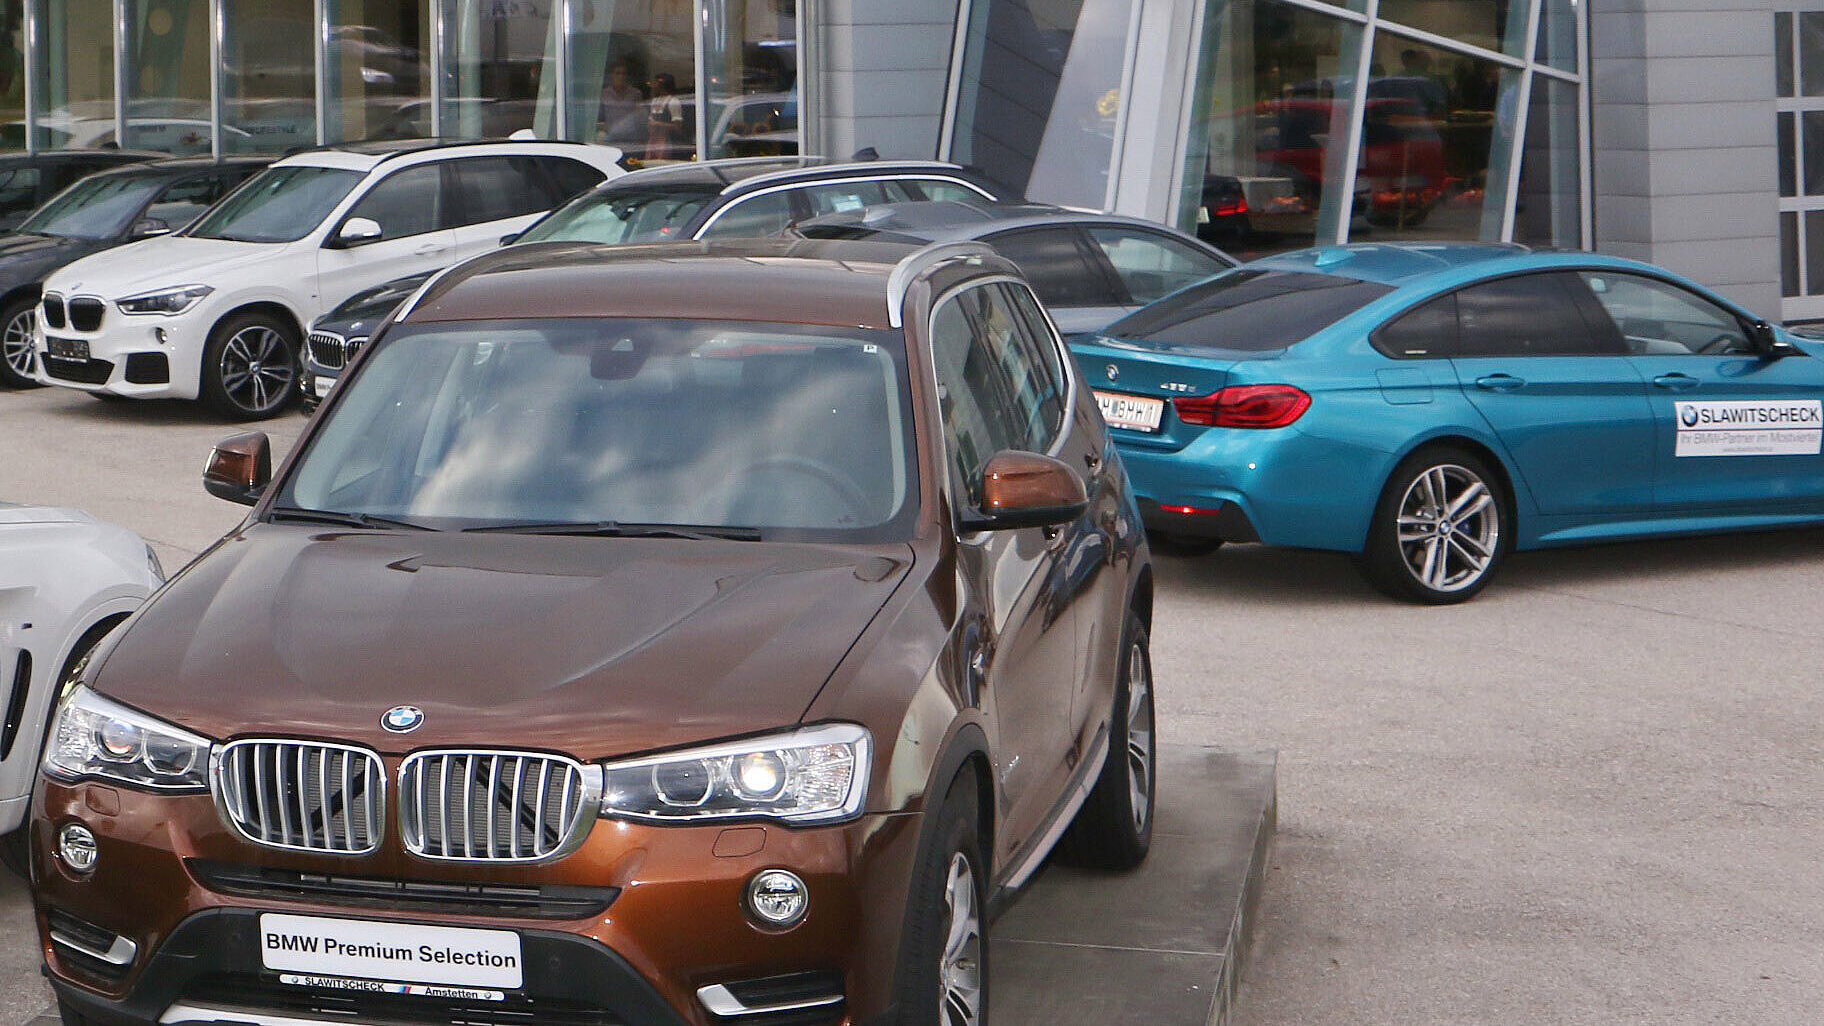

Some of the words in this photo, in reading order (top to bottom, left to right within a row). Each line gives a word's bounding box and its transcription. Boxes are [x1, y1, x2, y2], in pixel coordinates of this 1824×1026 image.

[1701, 407, 1820, 423] SLAWITSCHECK
[266, 933, 318, 953] BMW
[324, 938, 412, 961] Premium
[419, 946, 516, 968] Selection
[305, 976, 384, 992] SLAWITSCHECK
[425, 986, 478, 999] Amstetten
